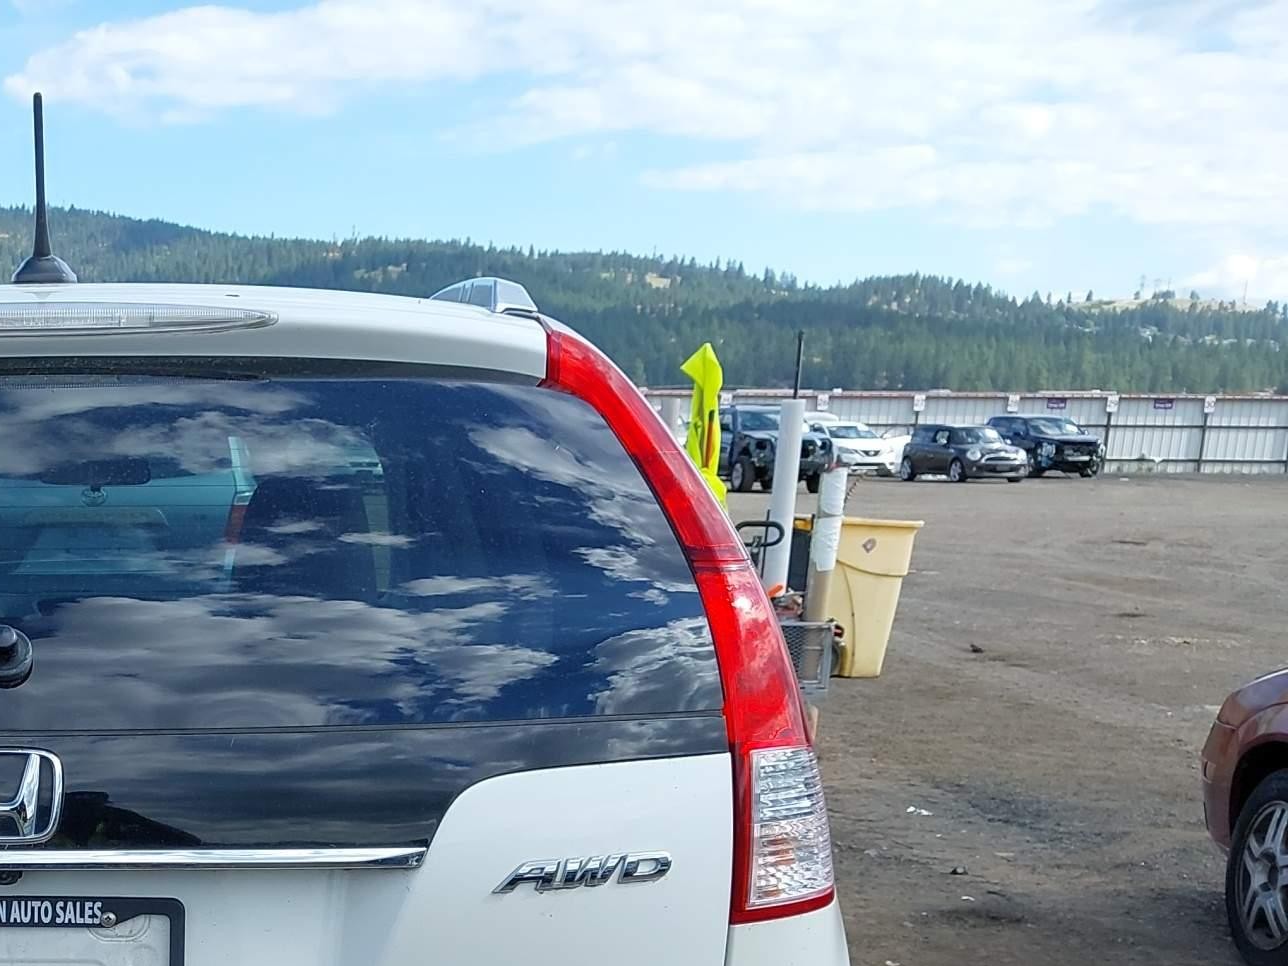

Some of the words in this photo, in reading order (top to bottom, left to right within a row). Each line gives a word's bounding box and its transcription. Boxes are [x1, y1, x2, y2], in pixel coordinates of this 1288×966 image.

[491, 850, 673, 894] AWD
[9, 901, 53, 924] AUTO
[55, 901, 103, 925] SALES
